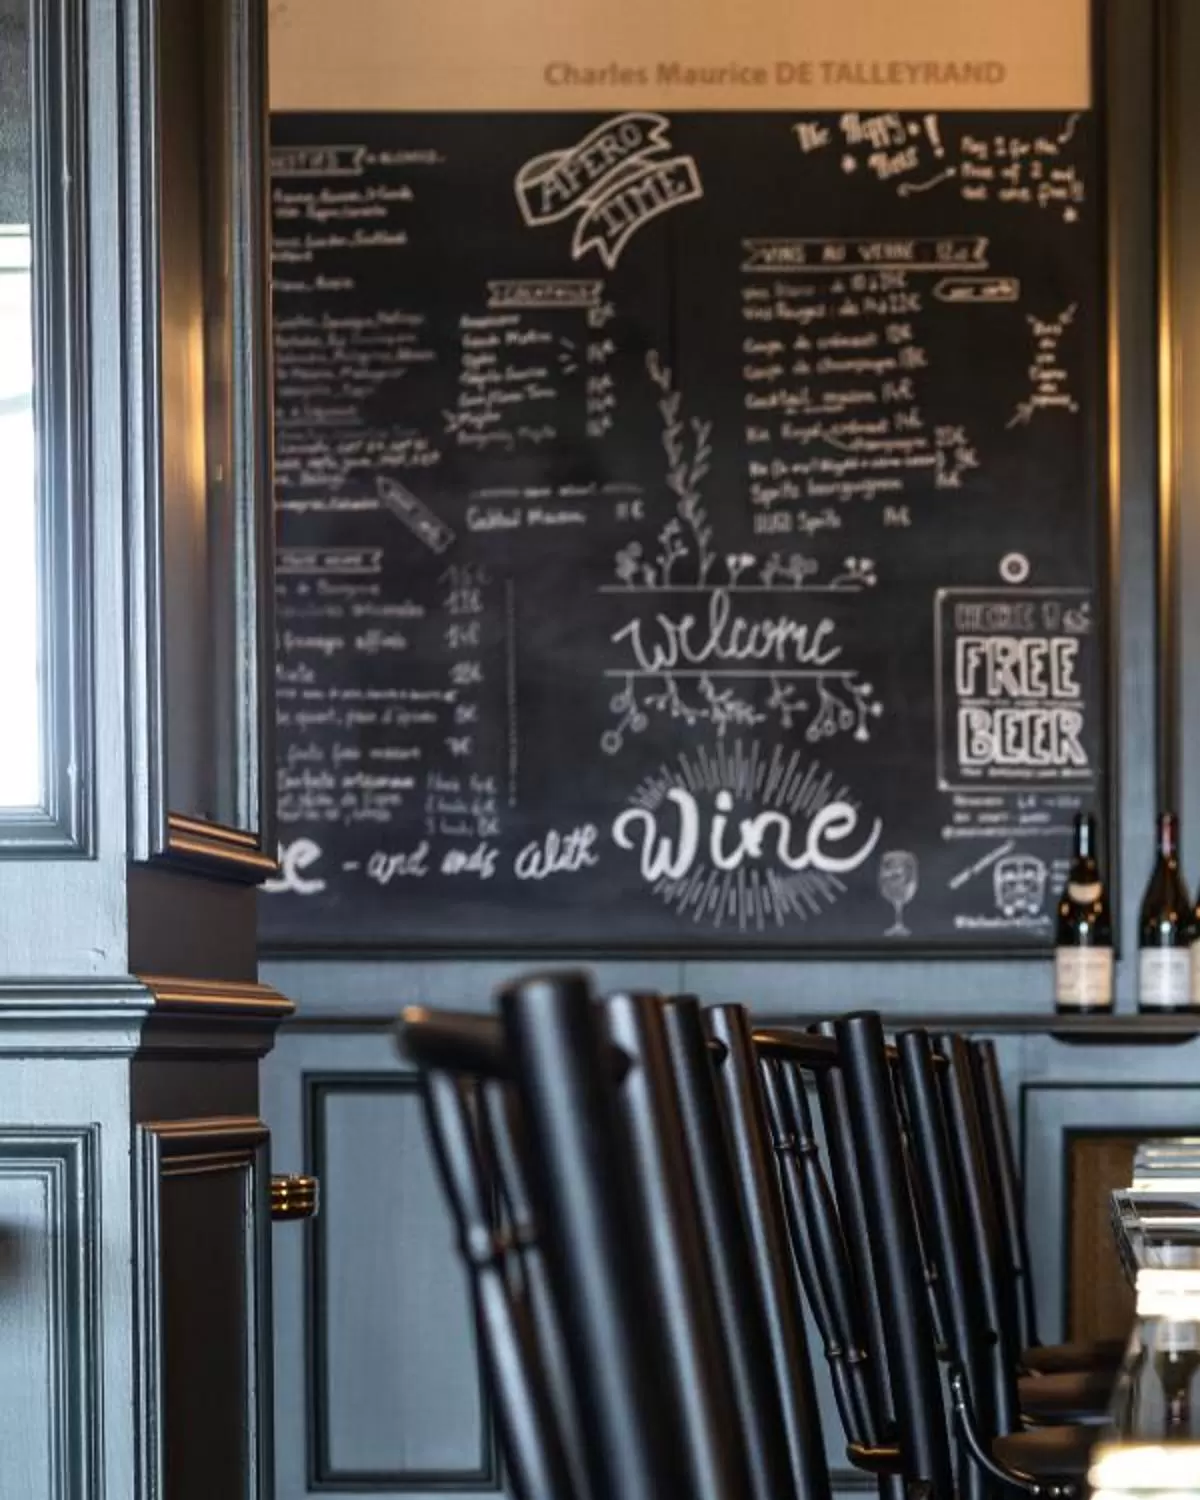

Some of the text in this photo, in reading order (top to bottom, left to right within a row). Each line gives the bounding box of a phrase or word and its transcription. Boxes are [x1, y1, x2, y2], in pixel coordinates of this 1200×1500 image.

[543, 61, 1007, 87] Charles Maurice DE TALLEYRAND
[540, 123, 644, 213] APERO
[590, 168, 688, 237] TIME
[955, 635, 1081, 697] FREE
[958, 707, 1089, 767] BEER
[611, 787, 883, 881] Wine
